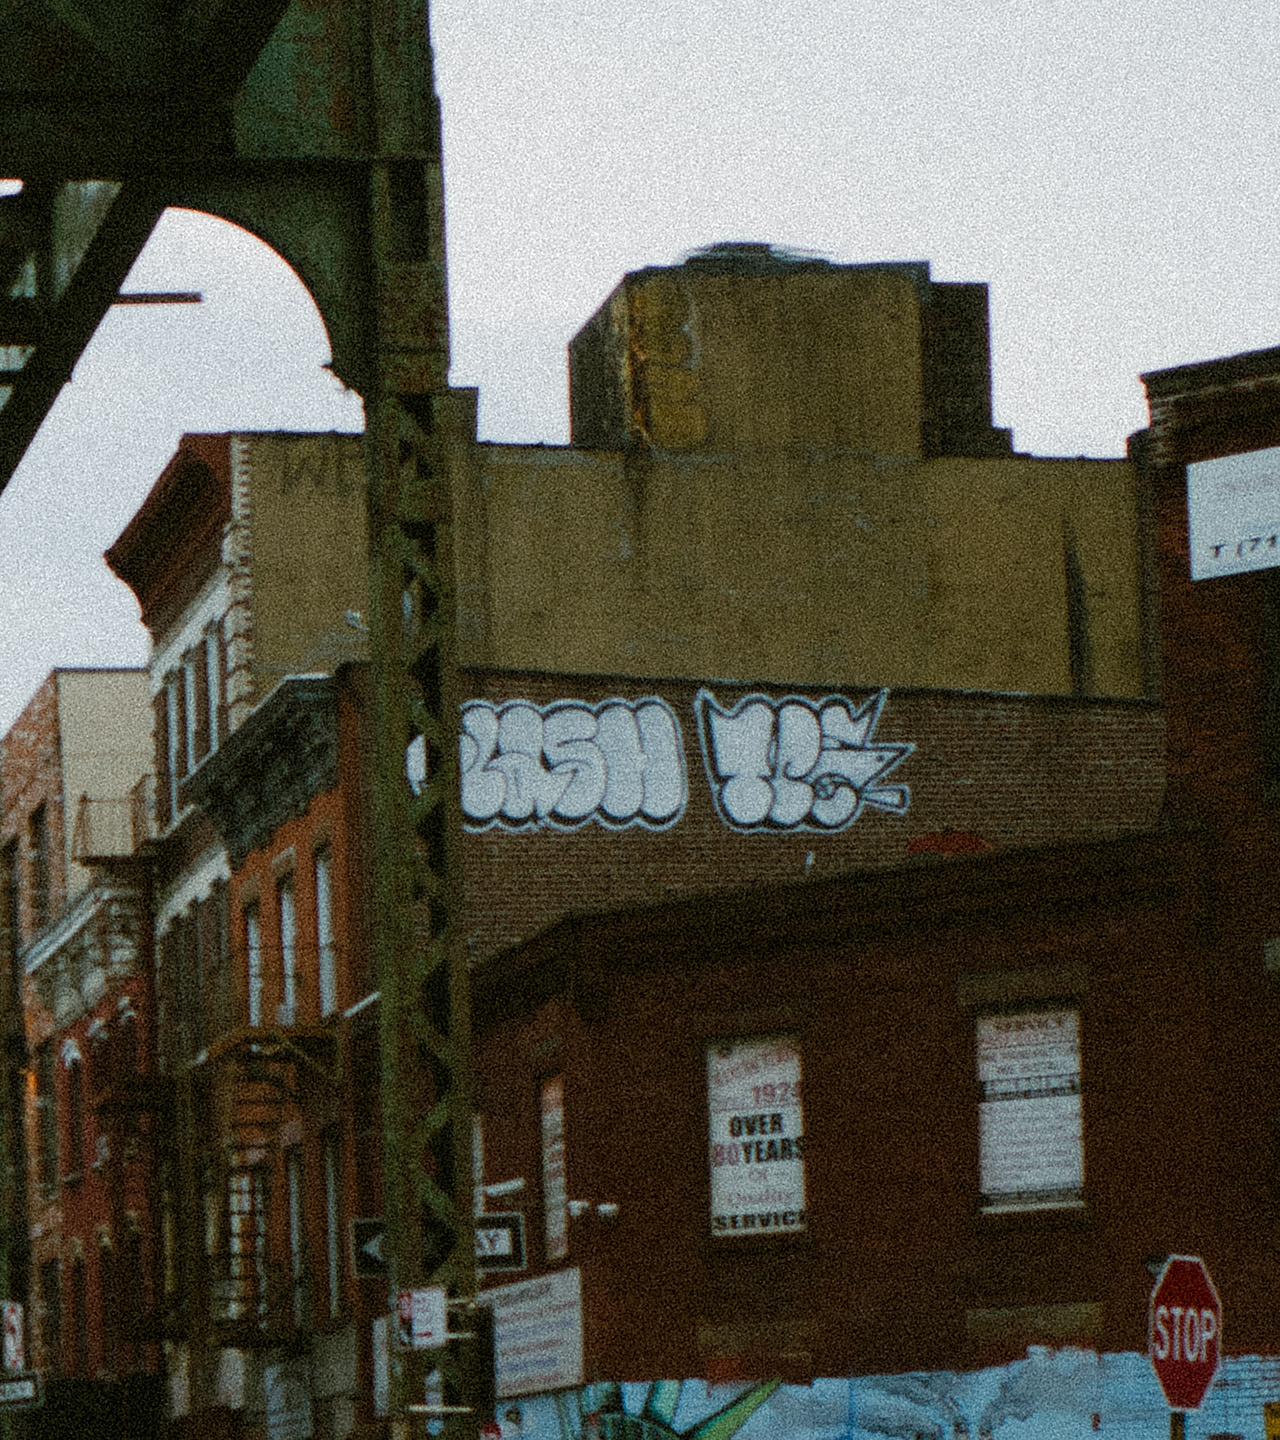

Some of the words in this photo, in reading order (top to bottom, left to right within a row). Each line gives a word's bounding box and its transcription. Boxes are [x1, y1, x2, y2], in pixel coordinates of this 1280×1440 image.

[729, 1113, 784, 1138] OVER
[712, 1143, 739, 1166] 80
[1153, 1305, 1217, 1363] STOP
